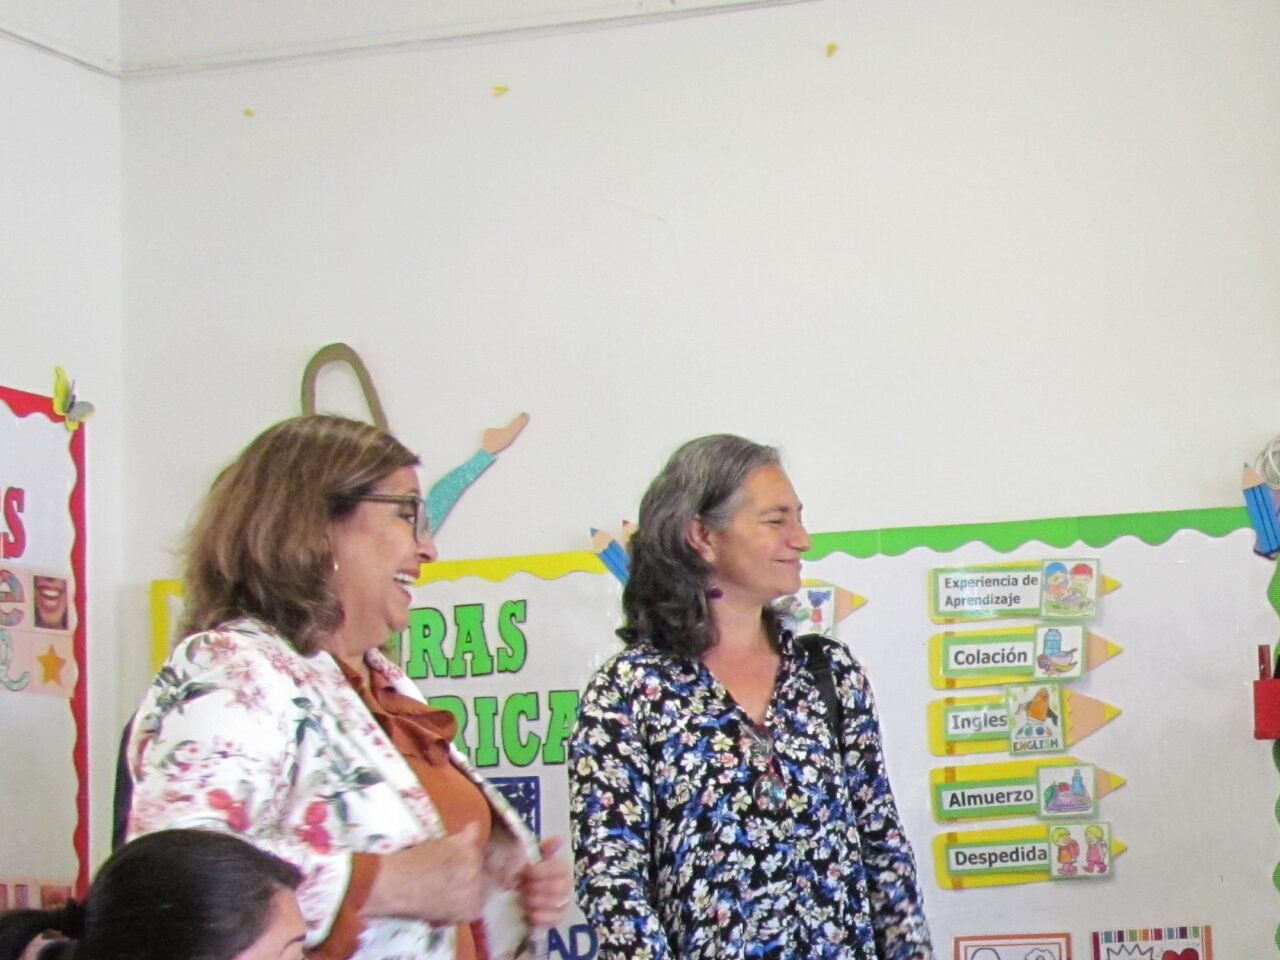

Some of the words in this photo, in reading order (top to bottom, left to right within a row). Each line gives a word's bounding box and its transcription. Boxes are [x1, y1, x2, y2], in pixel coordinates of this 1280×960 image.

[944, 575, 1018, 590] Experiencia
[1022, 574, 1039, 586] de
[944, 593, 1021, 608] Aprendizaje
[390, 600, 527, 679] RAS
[954, 648, 1028, 666] Colación
[951, 713, 1007, 732] Ingles
[1012, 739, 1058, 752] ENGLISH
[948, 787, 1034, 808] Almuerzo
[954, 846, 1048, 868] Despedida
